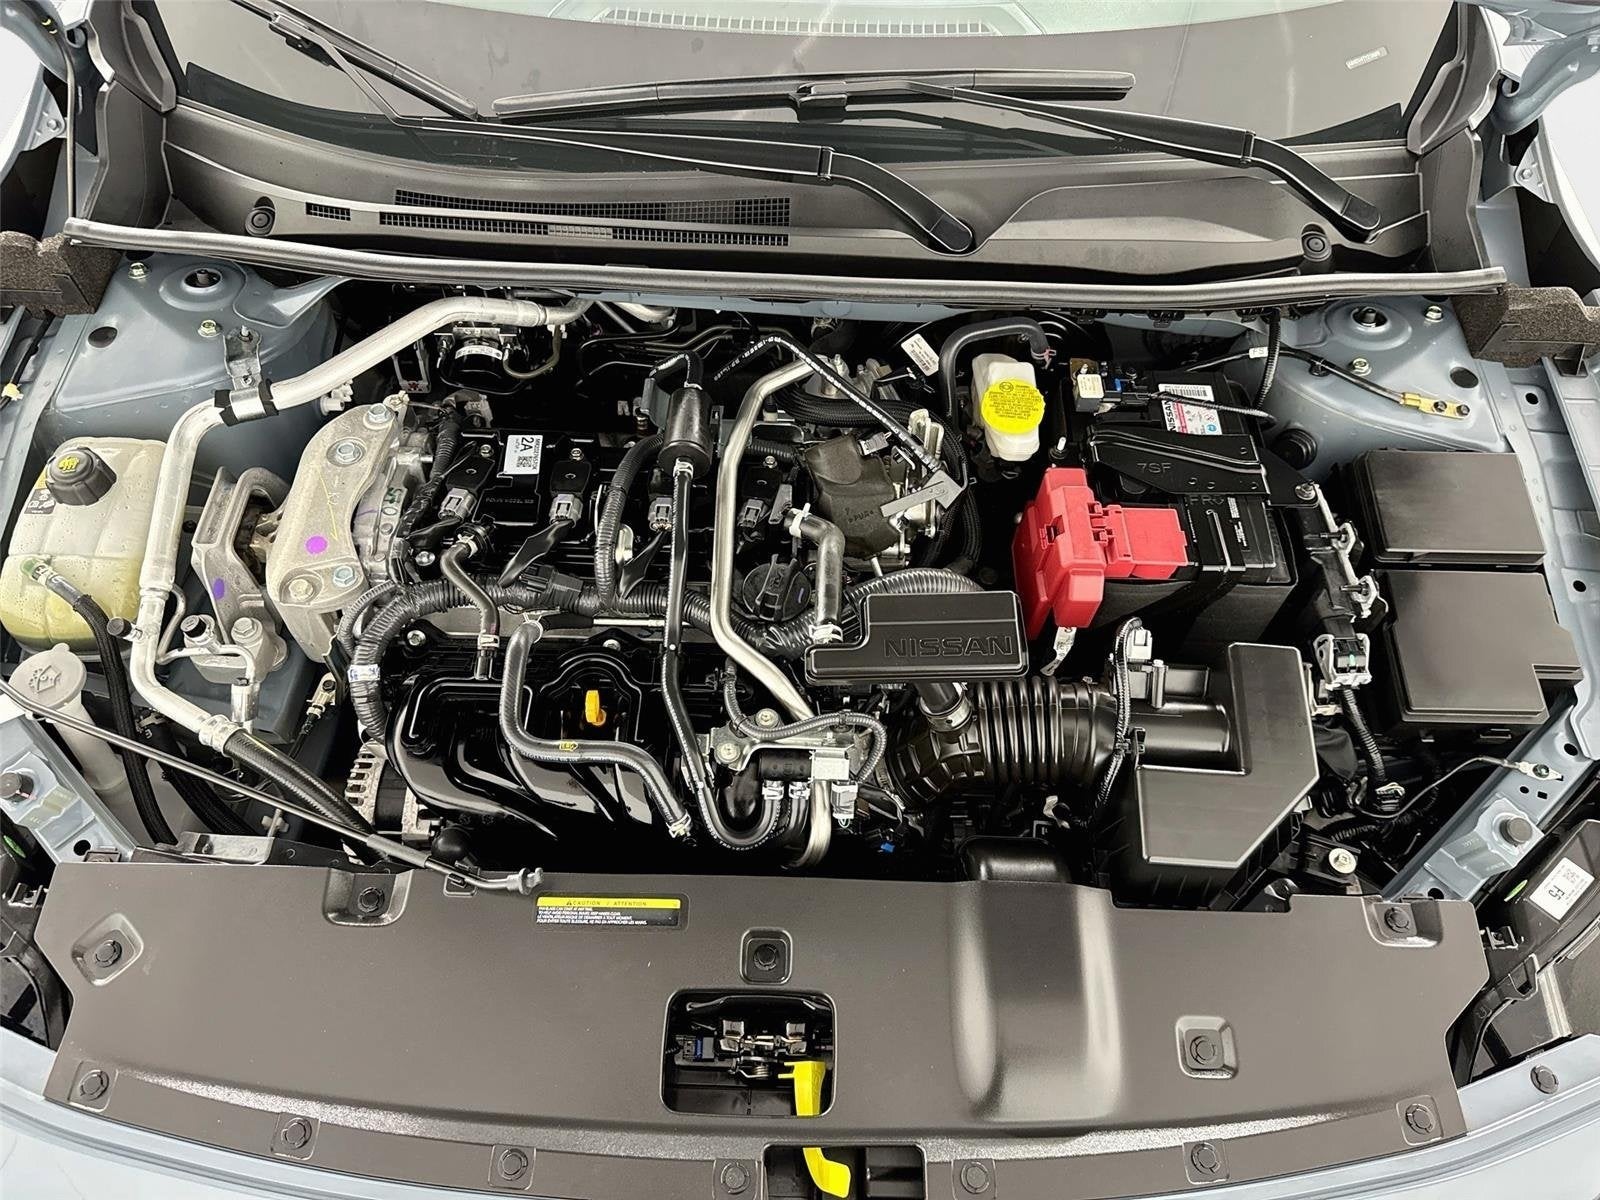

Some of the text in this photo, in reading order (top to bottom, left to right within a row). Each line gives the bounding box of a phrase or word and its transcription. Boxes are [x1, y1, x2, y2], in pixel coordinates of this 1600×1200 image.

[1163, 400, 1177, 432] NISSAN
[520, 437, 534, 452] 2A
[1137, 463, 1172, 474] 7SF
[884, 636, 1013, 658] NISSAN
[1549, 885, 1565, 900] F5
